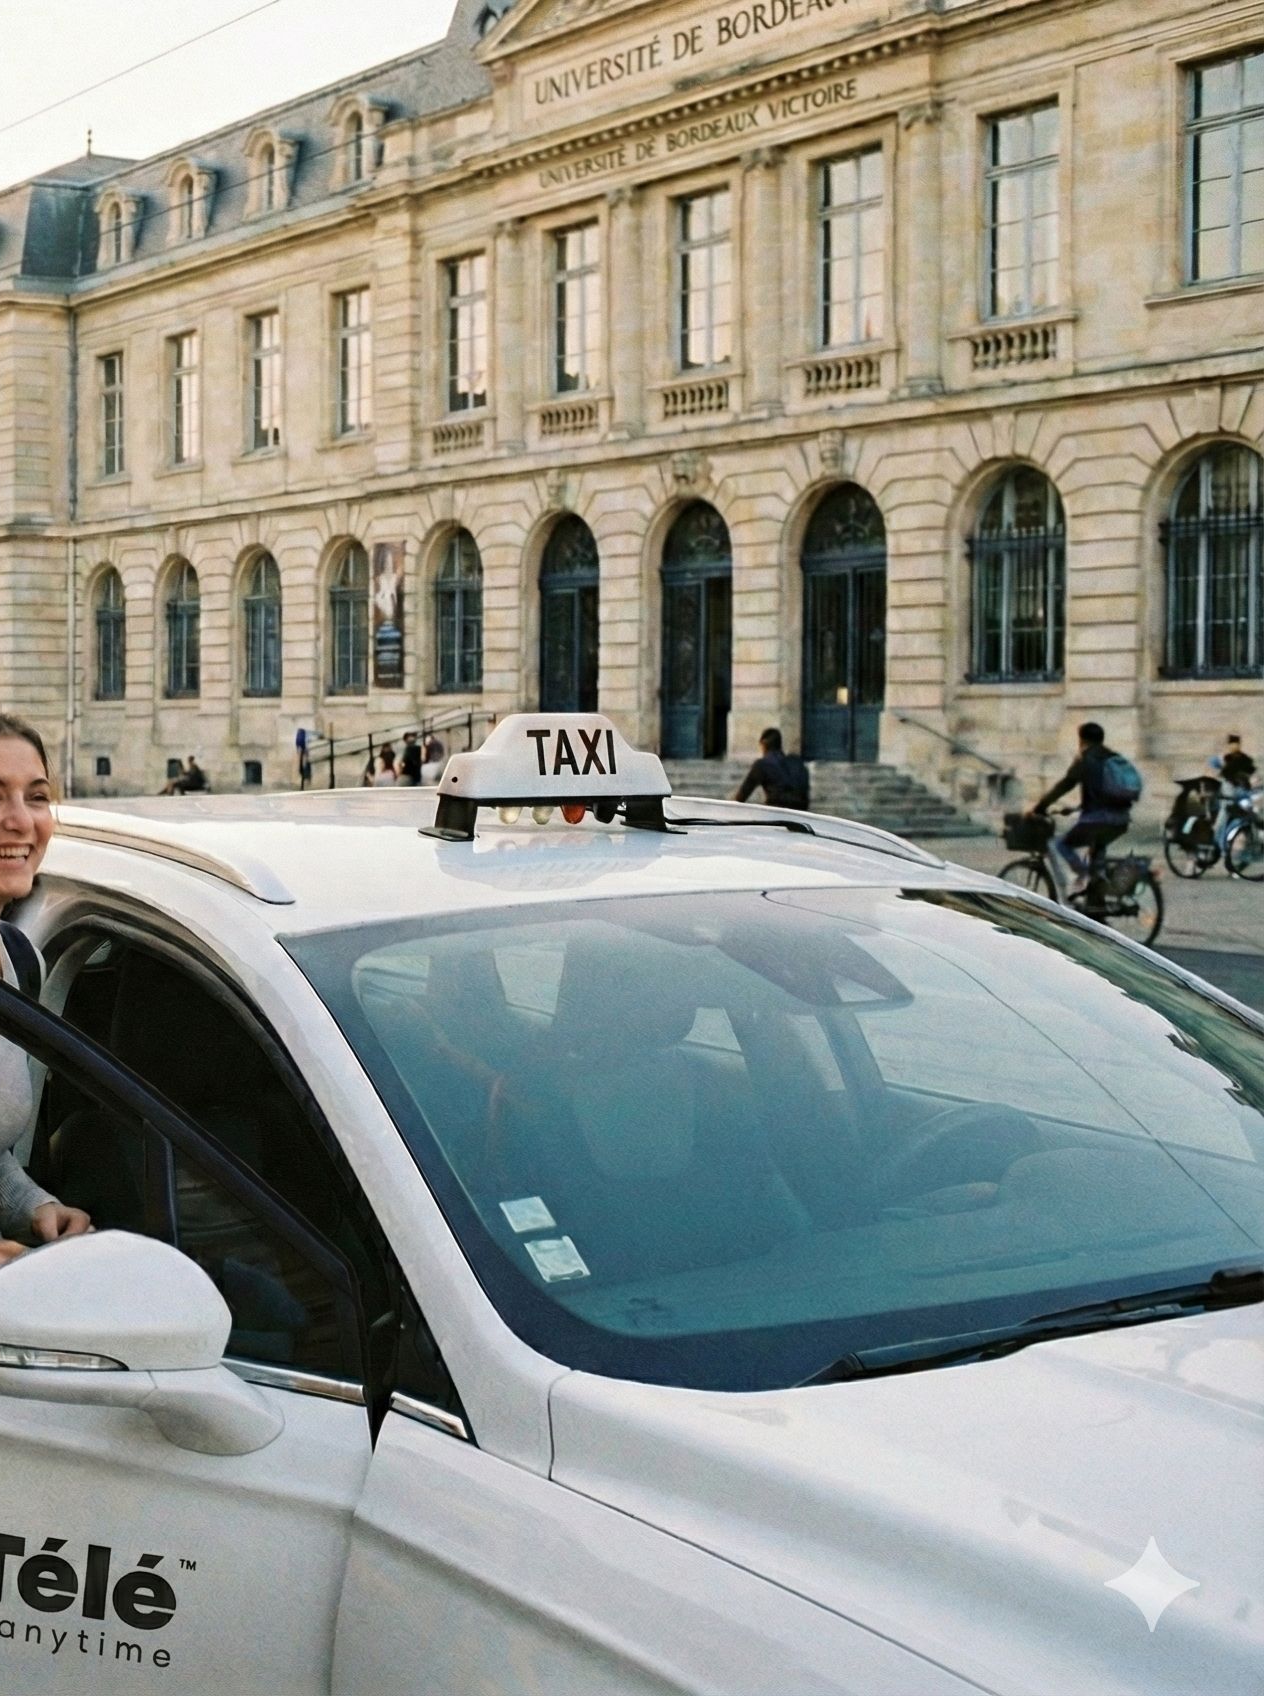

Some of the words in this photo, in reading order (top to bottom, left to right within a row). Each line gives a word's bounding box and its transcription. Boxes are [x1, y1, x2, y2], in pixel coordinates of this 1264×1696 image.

[534, 34, 663, 105] UNIVERSITÉ
[672, 24, 704, 61] DE
[666, 103, 759, 152] BORDEAUX
[767, 78, 857, 121] VICTOIRE
[526, 729, 617, 776] TAXI
